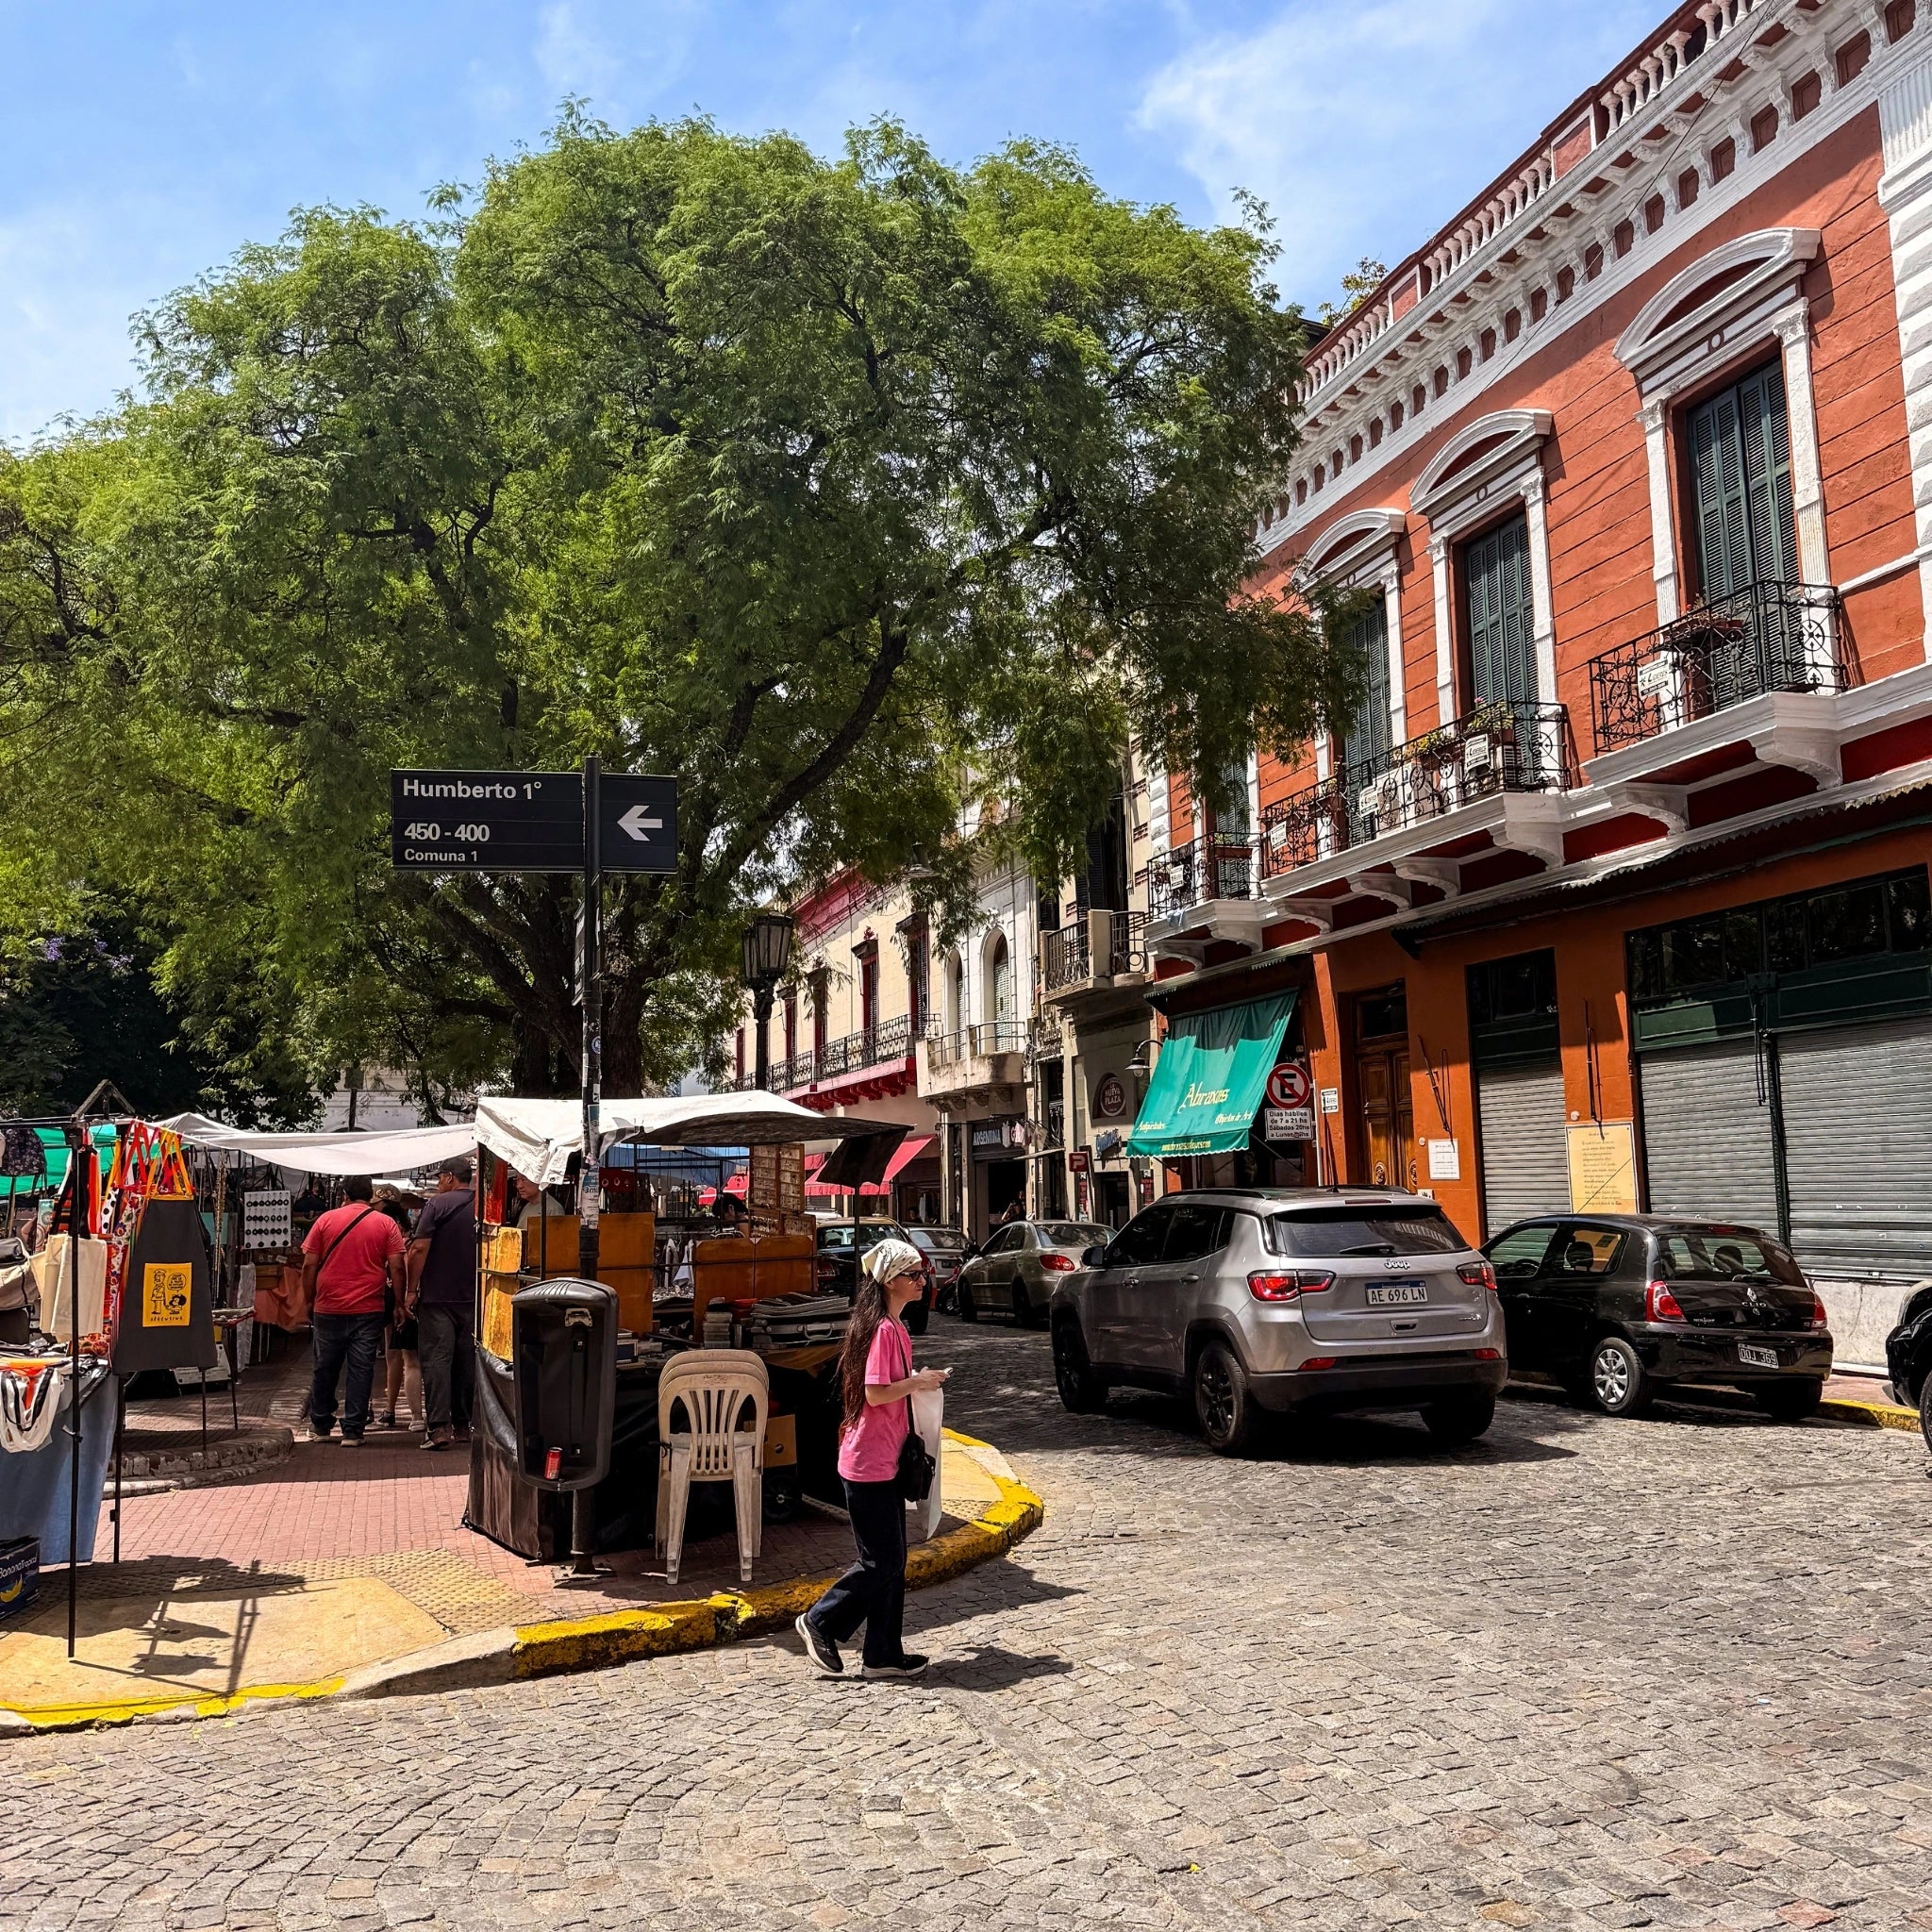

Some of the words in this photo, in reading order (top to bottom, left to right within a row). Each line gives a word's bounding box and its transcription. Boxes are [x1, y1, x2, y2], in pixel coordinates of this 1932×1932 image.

[403, 779, 516, 798] Humberto
[523, 781, 541, 800] 1°
[404, 849, 465, 861] Comuna
[471, 851, 477, 862] 1
[1106, 1088, 1121, 1096] NUEVA
[1177, 1081, 1230, 1114] Abraxas
[1106, 1096, 1121, 1105] PLAZA
[974, 1128, 1001, 1145] ARGENTINA
[1372, 1291, 1384, 1302] AE
[1389, 1290, 1407, 1301] 696
[1411, 1289, 1425, 1300] LN
[1760, 1353, 1776, 1364] 369
